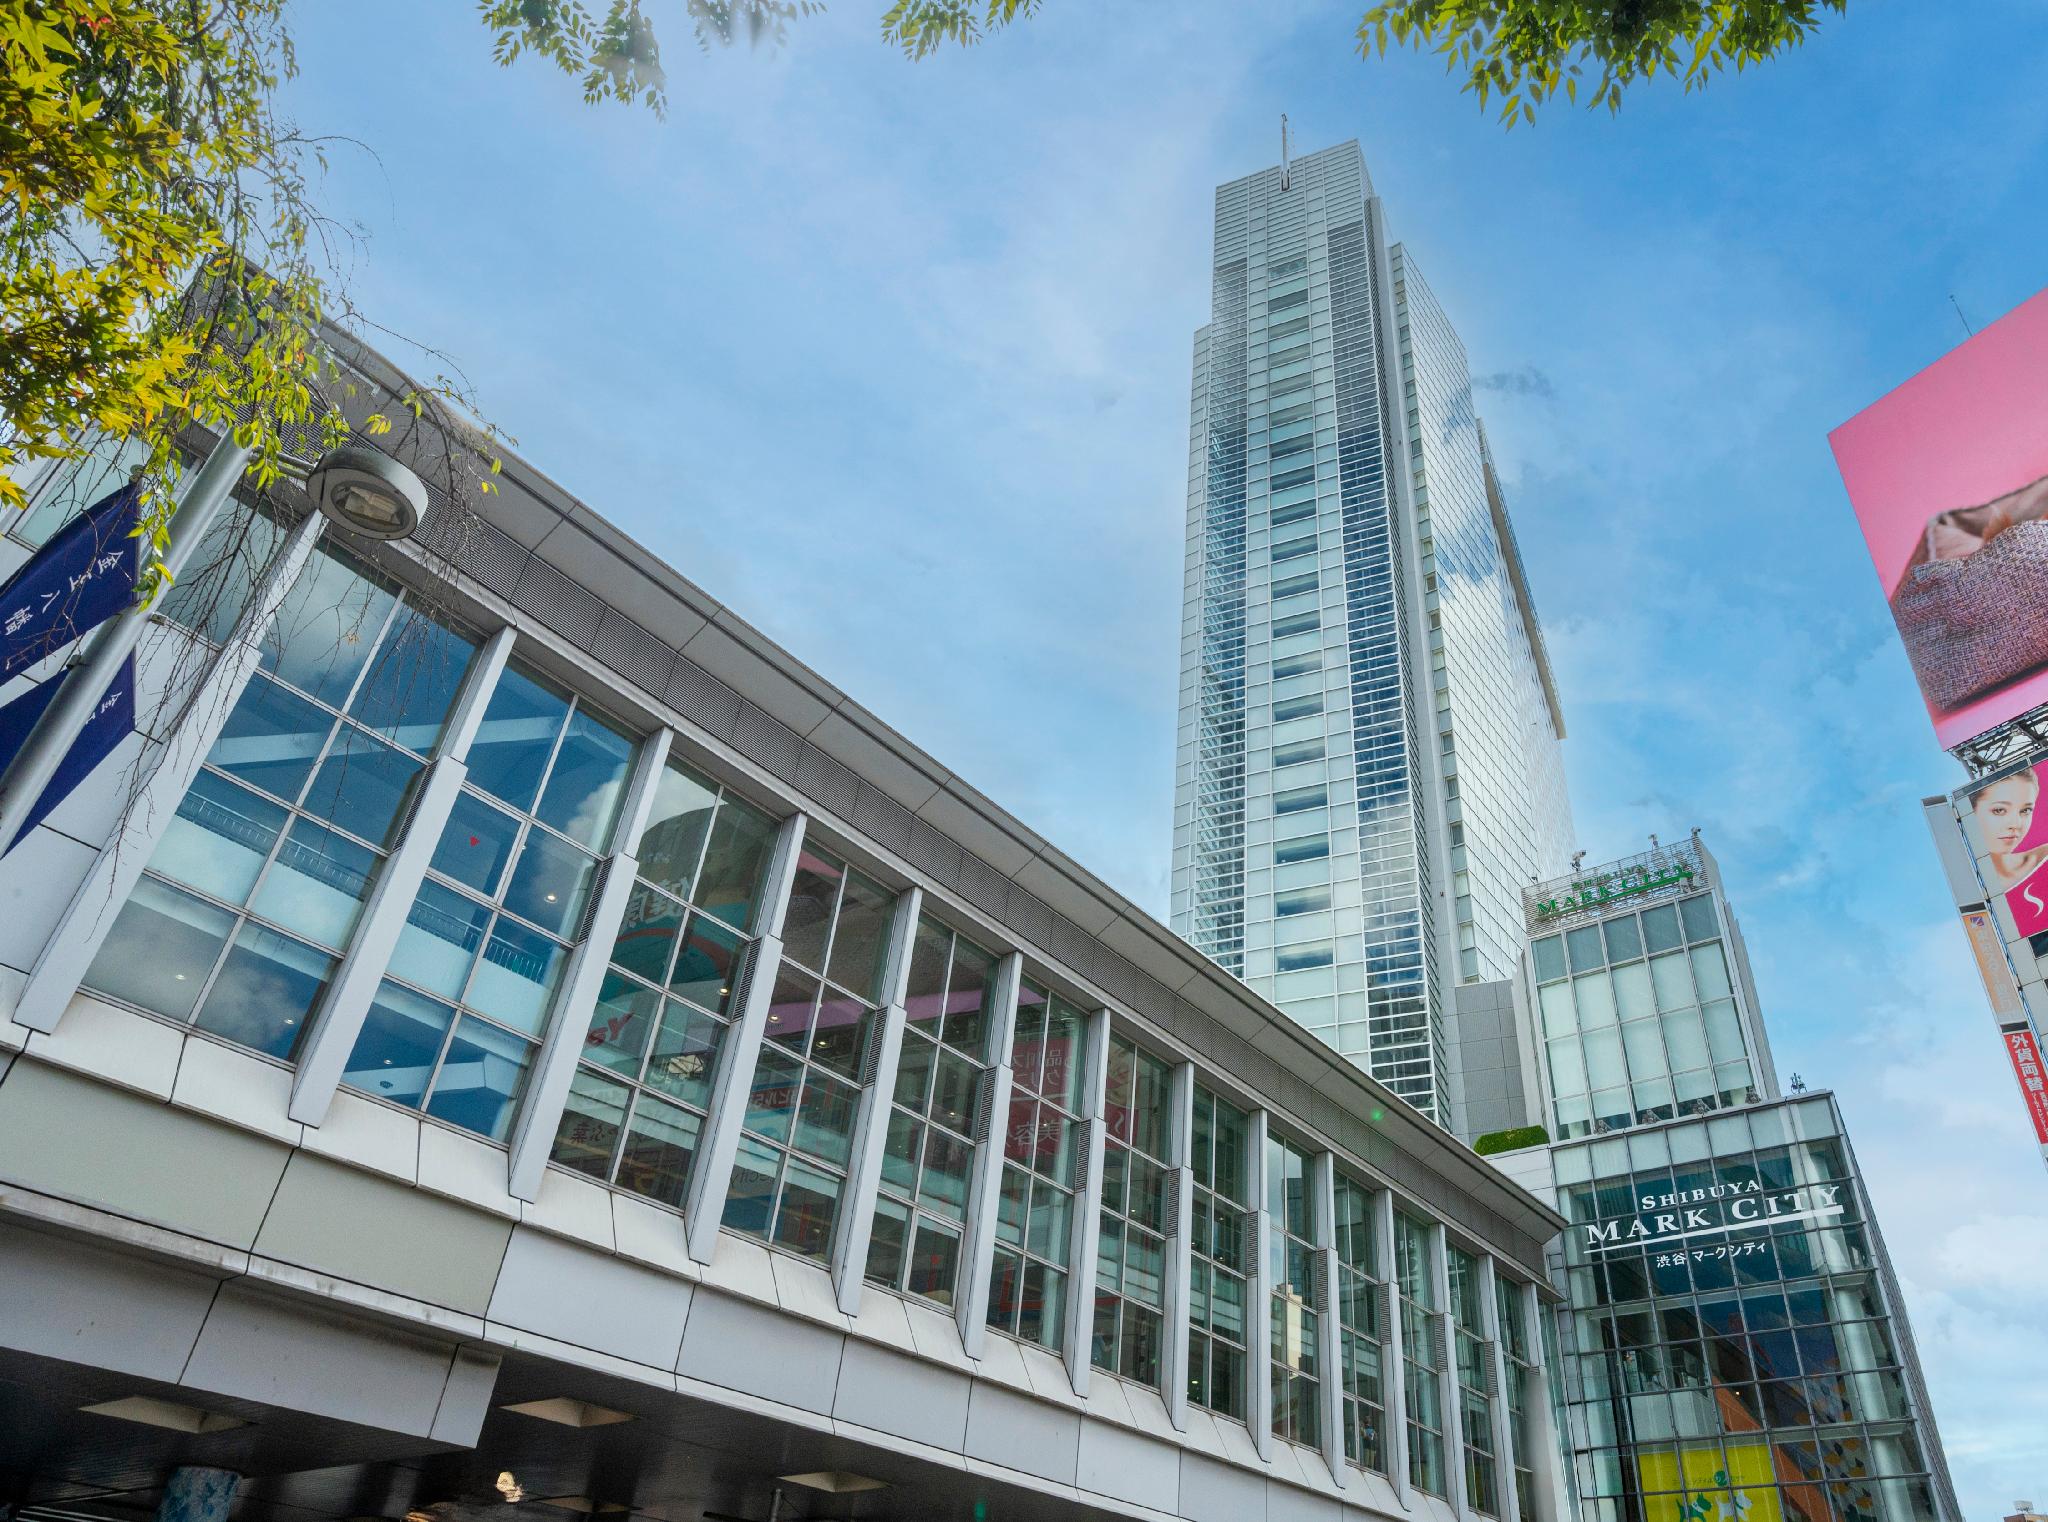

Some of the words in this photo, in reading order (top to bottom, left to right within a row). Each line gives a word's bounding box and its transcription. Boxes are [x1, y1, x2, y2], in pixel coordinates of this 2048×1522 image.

[1537, 886, 1611, 914] MARK
[1621, 864, 1690, 890] CITY
[2011, 1033, 2045, 1092] 外貨両替
[1586, 1206, 1712, 1247] MARK
[1731, 1185, 1841, 1220] CITY
[1641, 1180, 1761, 1211] SHIBUYA
